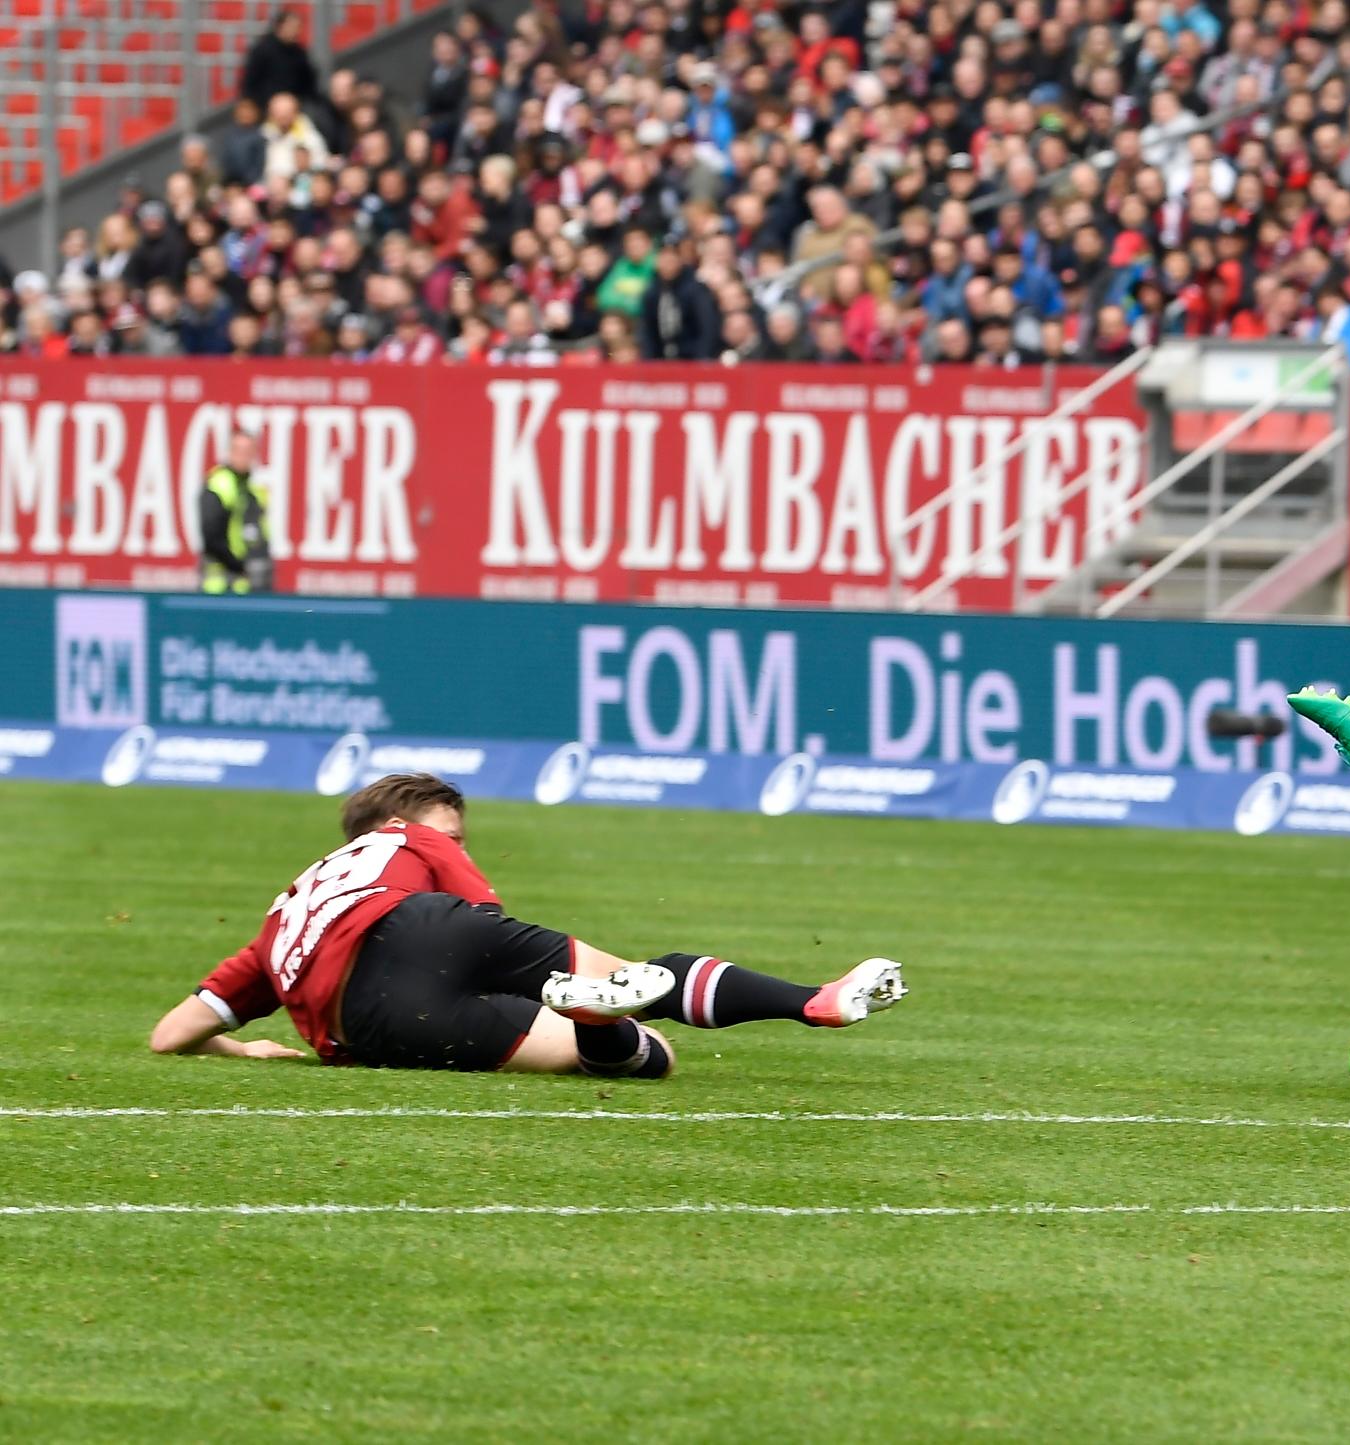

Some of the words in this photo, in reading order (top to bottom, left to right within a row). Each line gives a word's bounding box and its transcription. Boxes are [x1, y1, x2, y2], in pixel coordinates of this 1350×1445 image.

[482, 379, 1144, 578] KULMBACHER
[577, 625, 826, 756] FOM.
[869, 631, 1022, 766] Die
